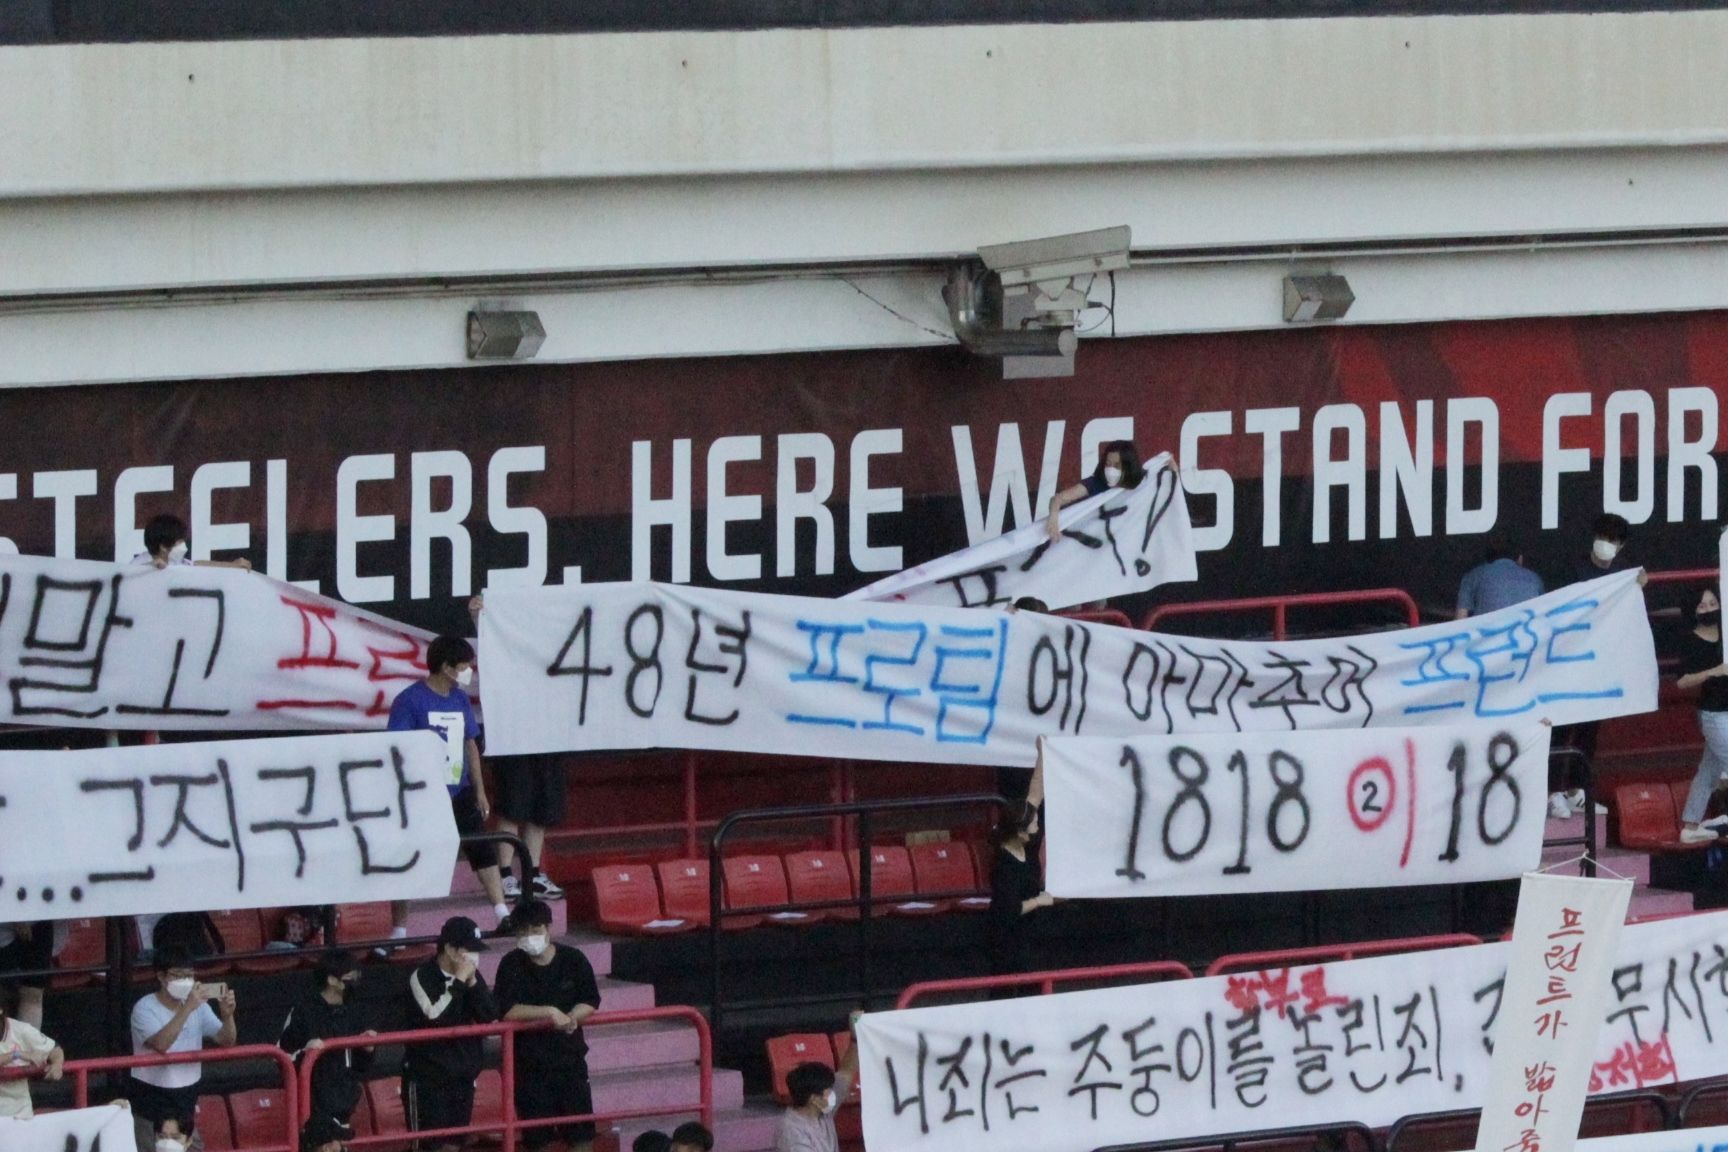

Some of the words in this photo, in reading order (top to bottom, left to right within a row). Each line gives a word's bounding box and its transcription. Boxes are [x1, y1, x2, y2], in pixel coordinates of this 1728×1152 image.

[632, 428, 903, 584] HERE
[1179, 397, 1499, 551] STAND
[1541, 386, 1719, 530] FOR
[0, 574, 229, 717] 말고
[548, 603, 750, 726] 48년
[1122, 642, 1378, 735] 아마추어
